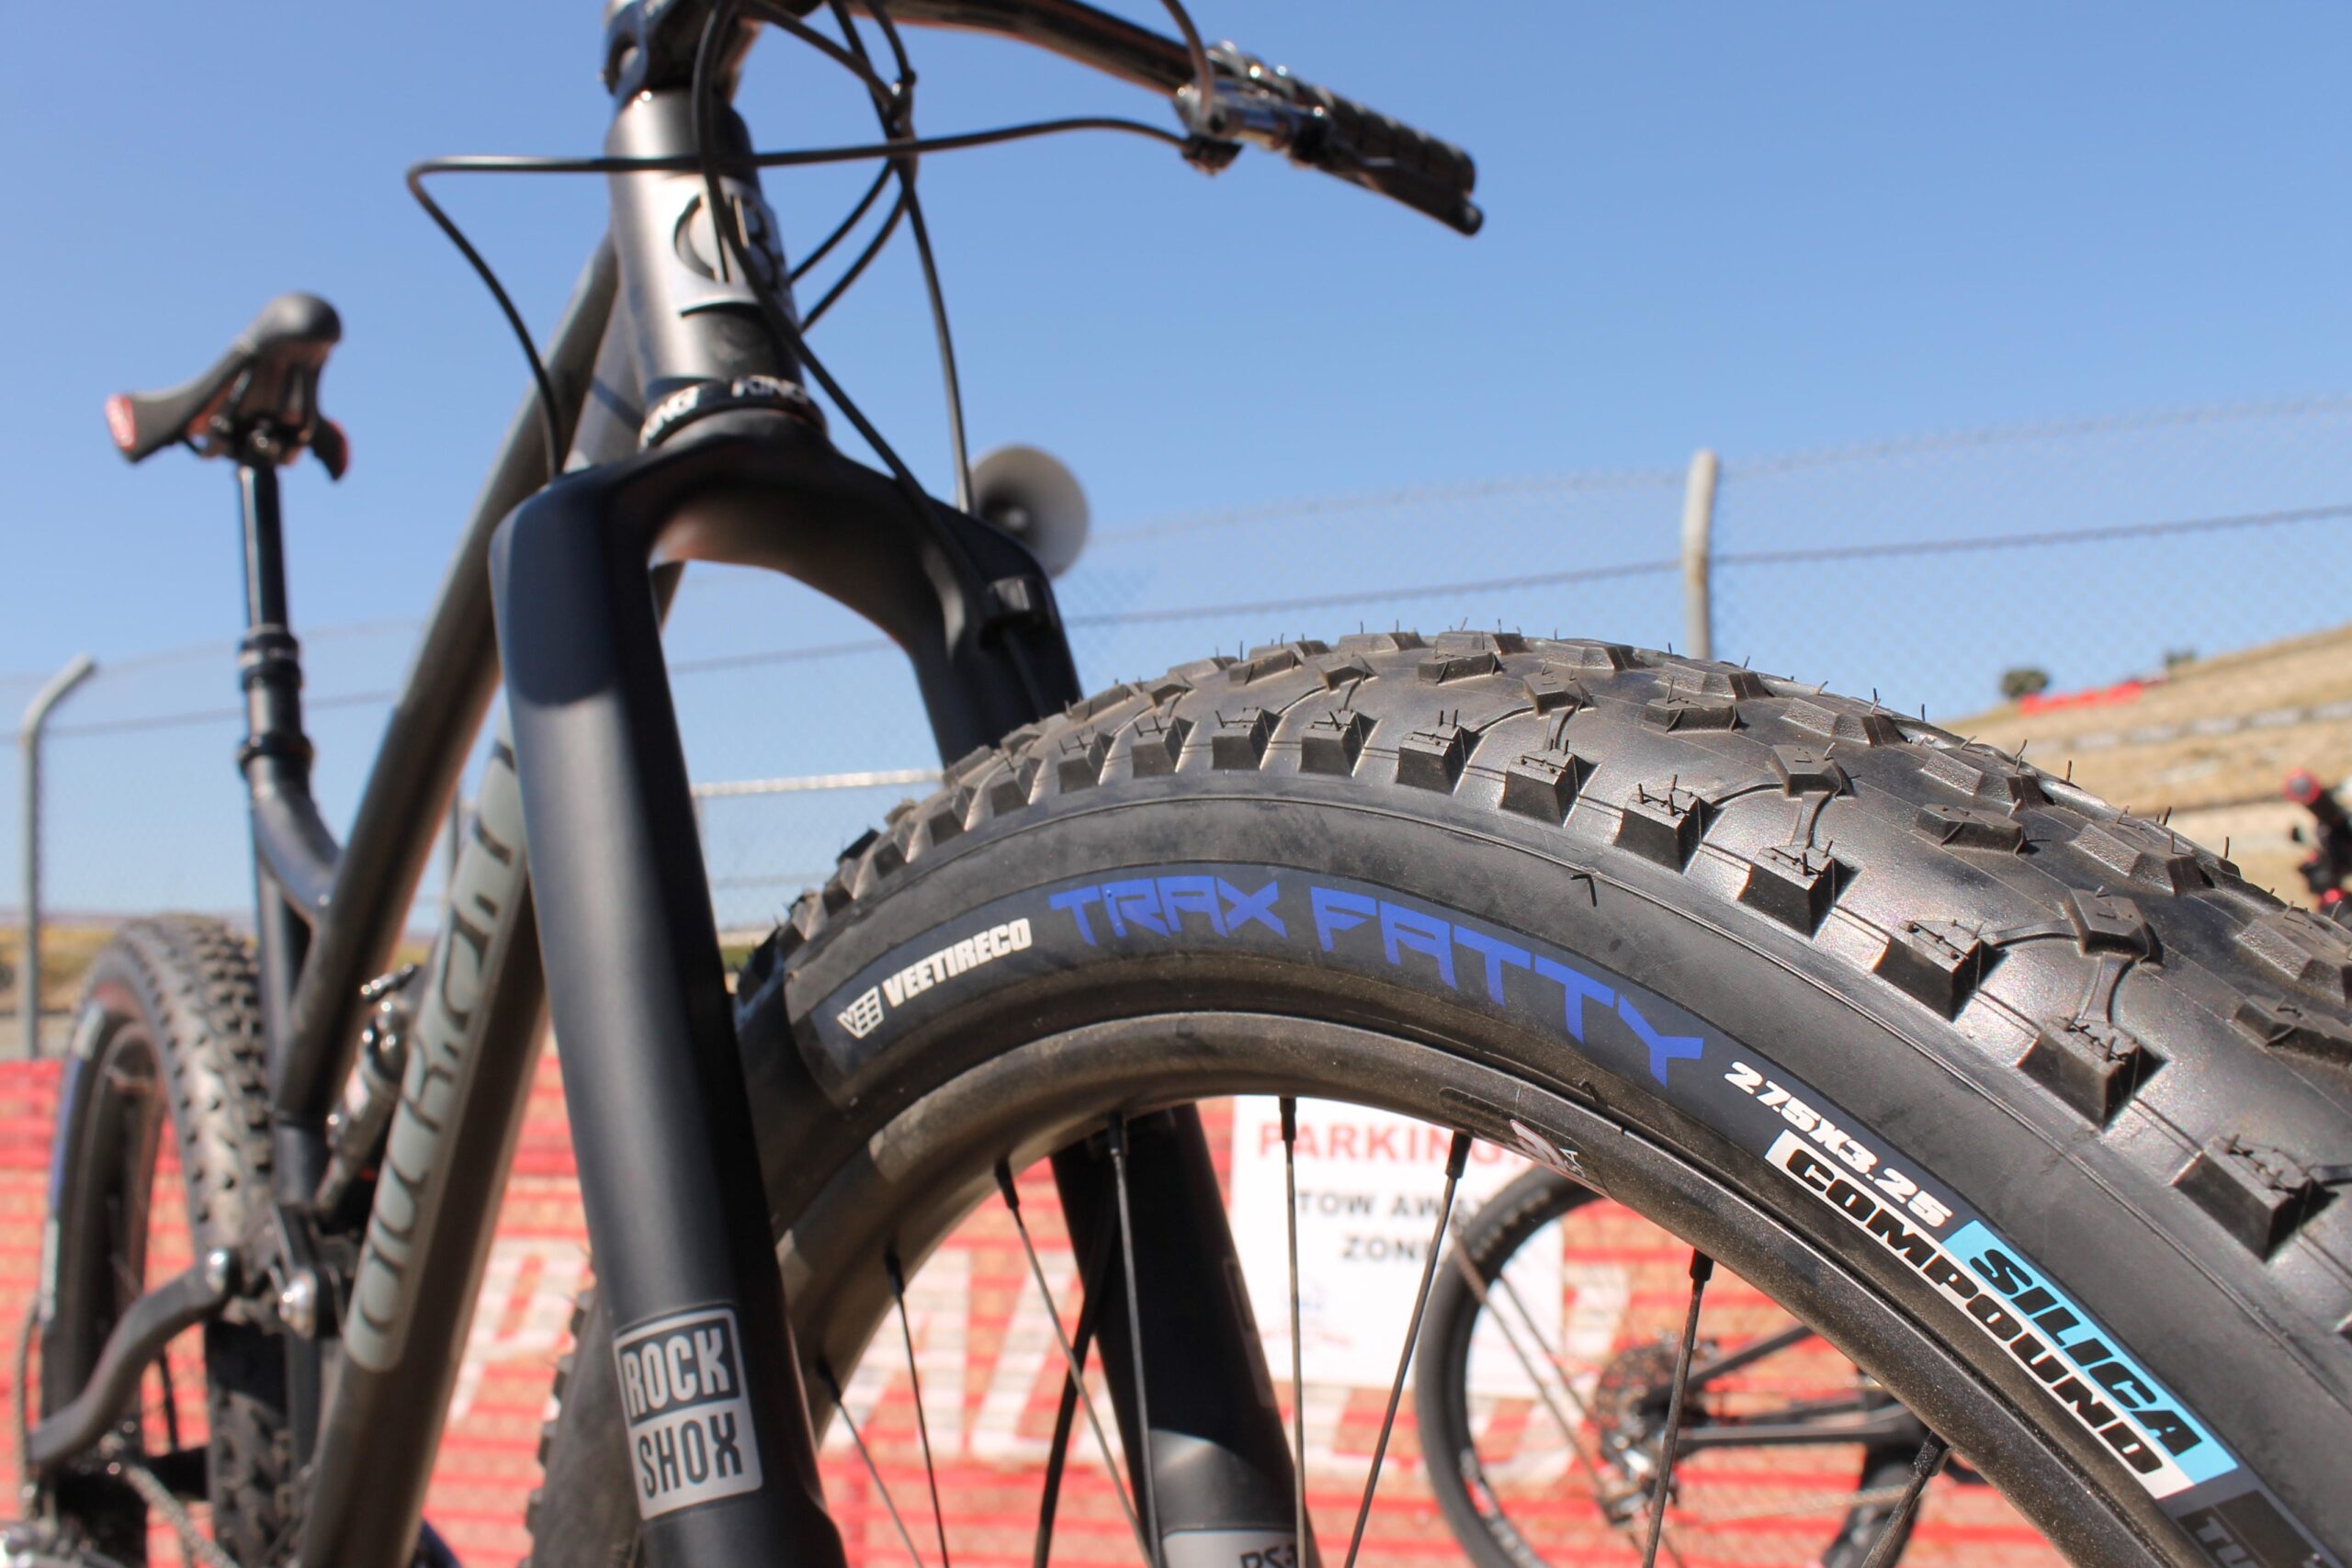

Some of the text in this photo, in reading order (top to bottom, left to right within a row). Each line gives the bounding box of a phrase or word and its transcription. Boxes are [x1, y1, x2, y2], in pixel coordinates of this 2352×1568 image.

[882, 917, 1032, 1008] VEETIRECO
[1049, 874, 1704, 1089] TRAX FATTY
[1295, 1190, 1375, 1217] TOW
[1340, 1235, 1431, 1262] ZON
[1785, 1147, 2164, 1475] COMPOUND
[1969, 1248, 2203, 1458] SILICA
[621, 1326, 730, 1419] ROCK
[638, 1411, 744, 1499] SHOX
